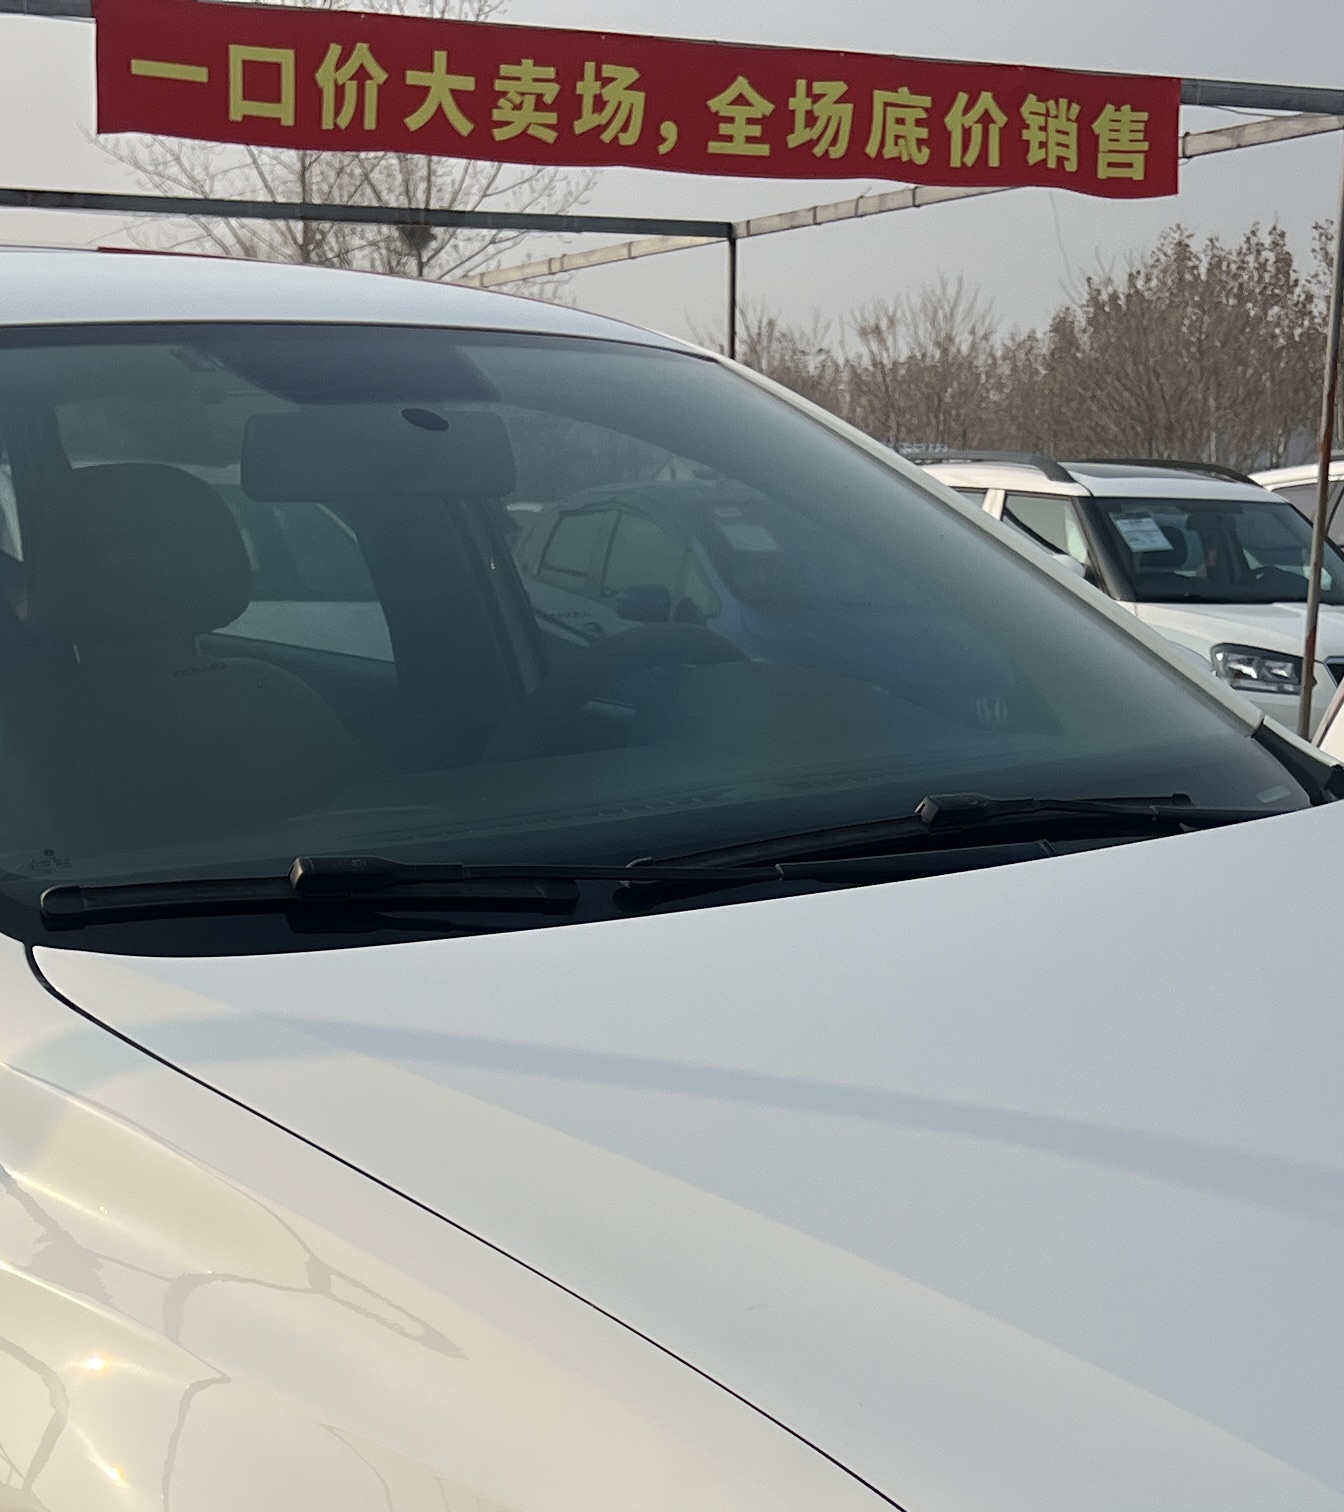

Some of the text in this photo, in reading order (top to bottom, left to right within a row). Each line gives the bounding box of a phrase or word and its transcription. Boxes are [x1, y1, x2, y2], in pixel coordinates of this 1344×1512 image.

[130, 42, 1150, 181] 一口价大卖场，全场底价销售
